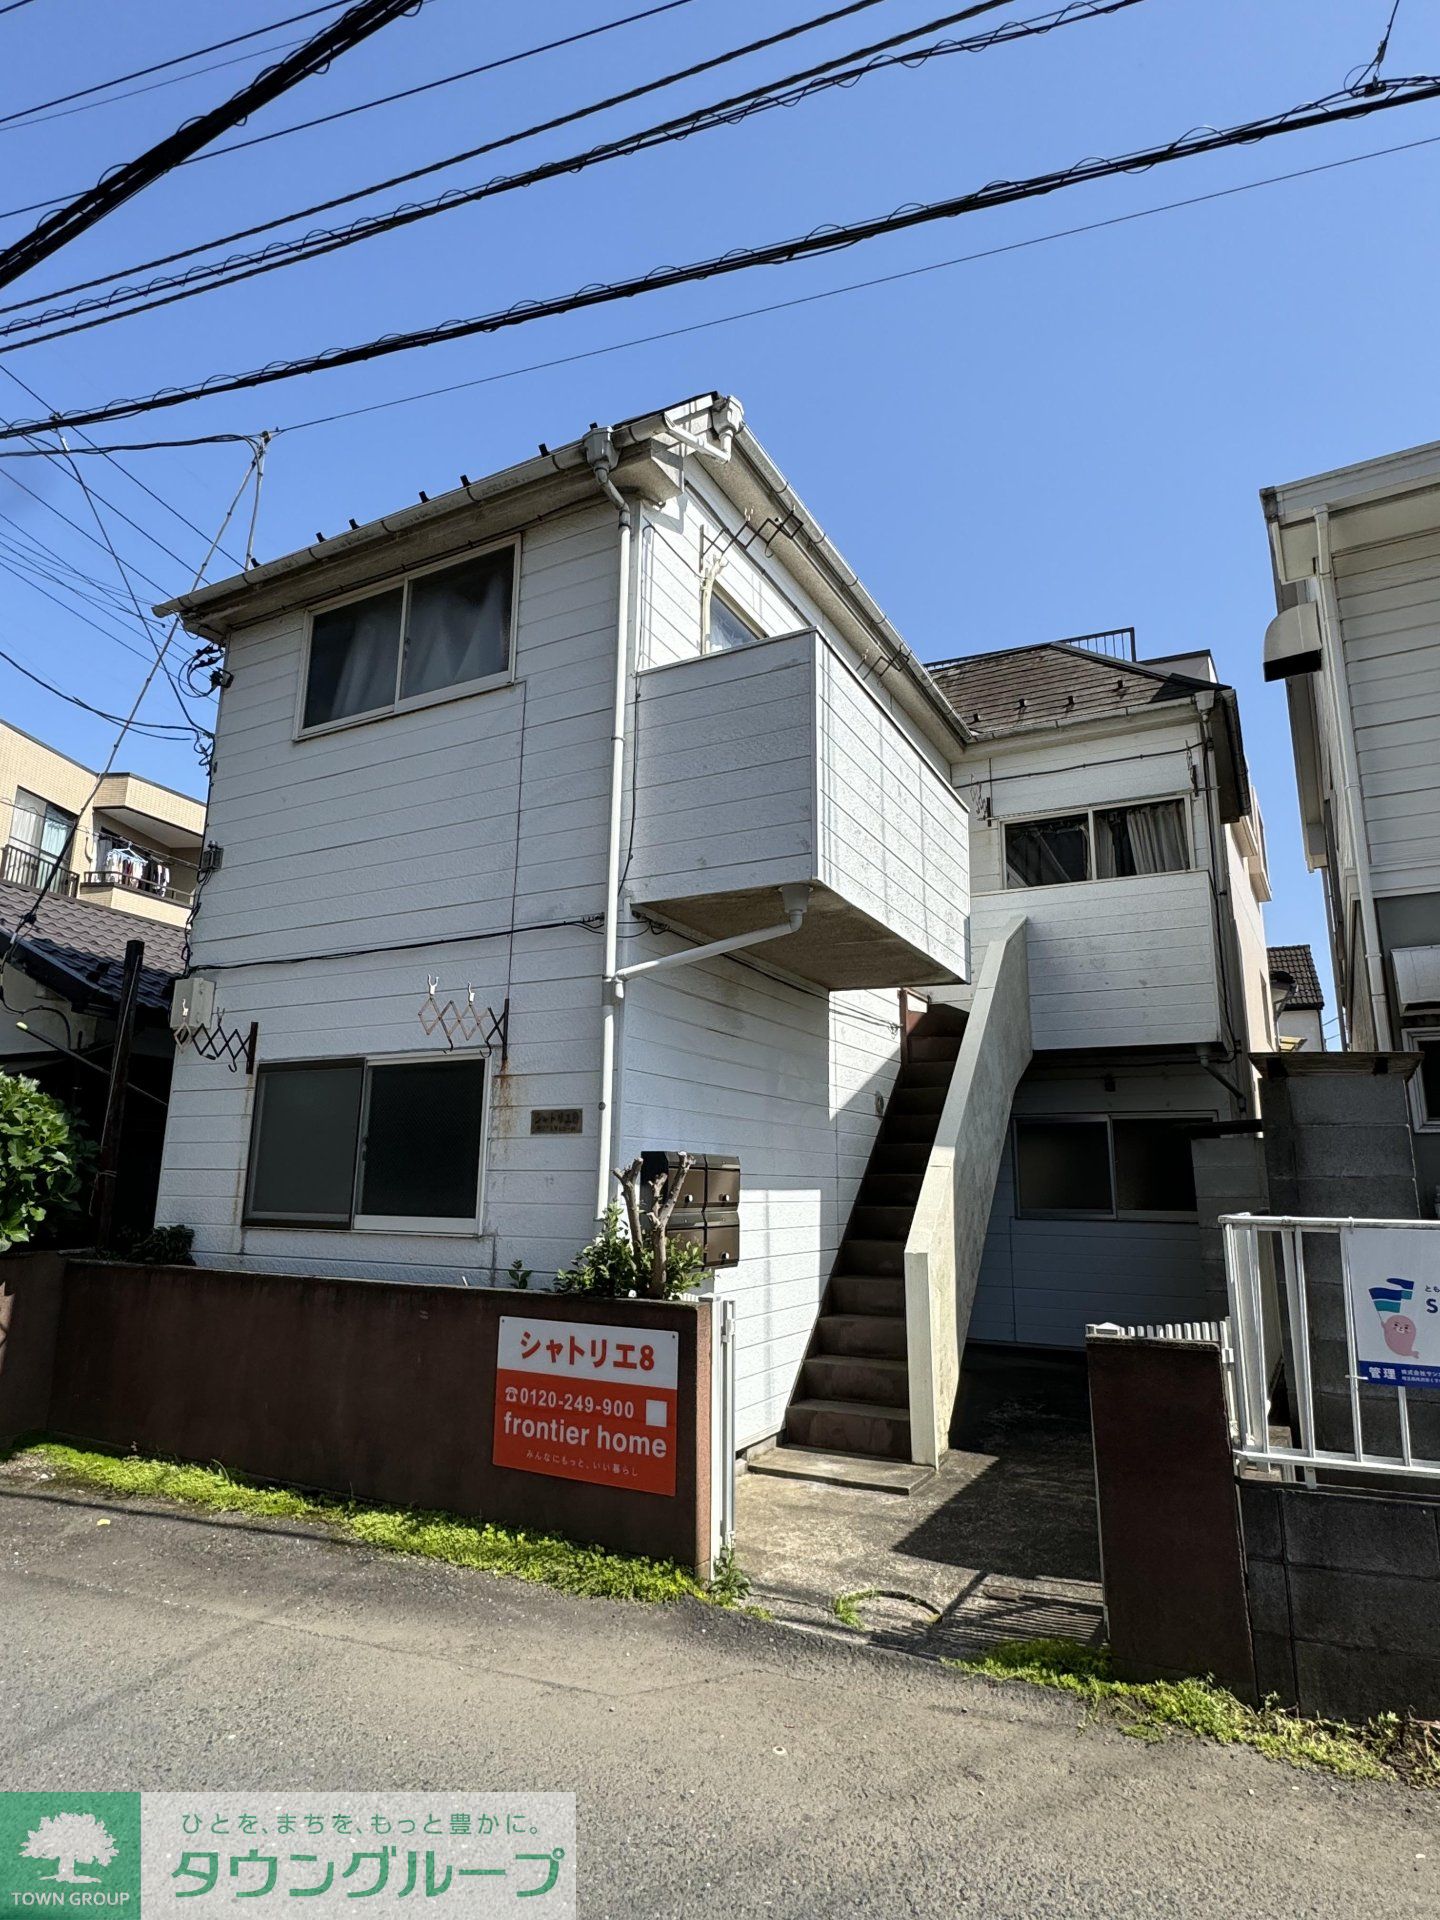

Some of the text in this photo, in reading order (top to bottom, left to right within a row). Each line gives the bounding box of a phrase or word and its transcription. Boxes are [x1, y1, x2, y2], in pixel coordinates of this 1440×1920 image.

[520, 1331, 655, 1371] シャトリエ8
[1369, 1366, 1397, 1380] 管理
[519, 1387, 634, 1419] 0120-249-900
[504, 1411, 667, 1458] frontier home
